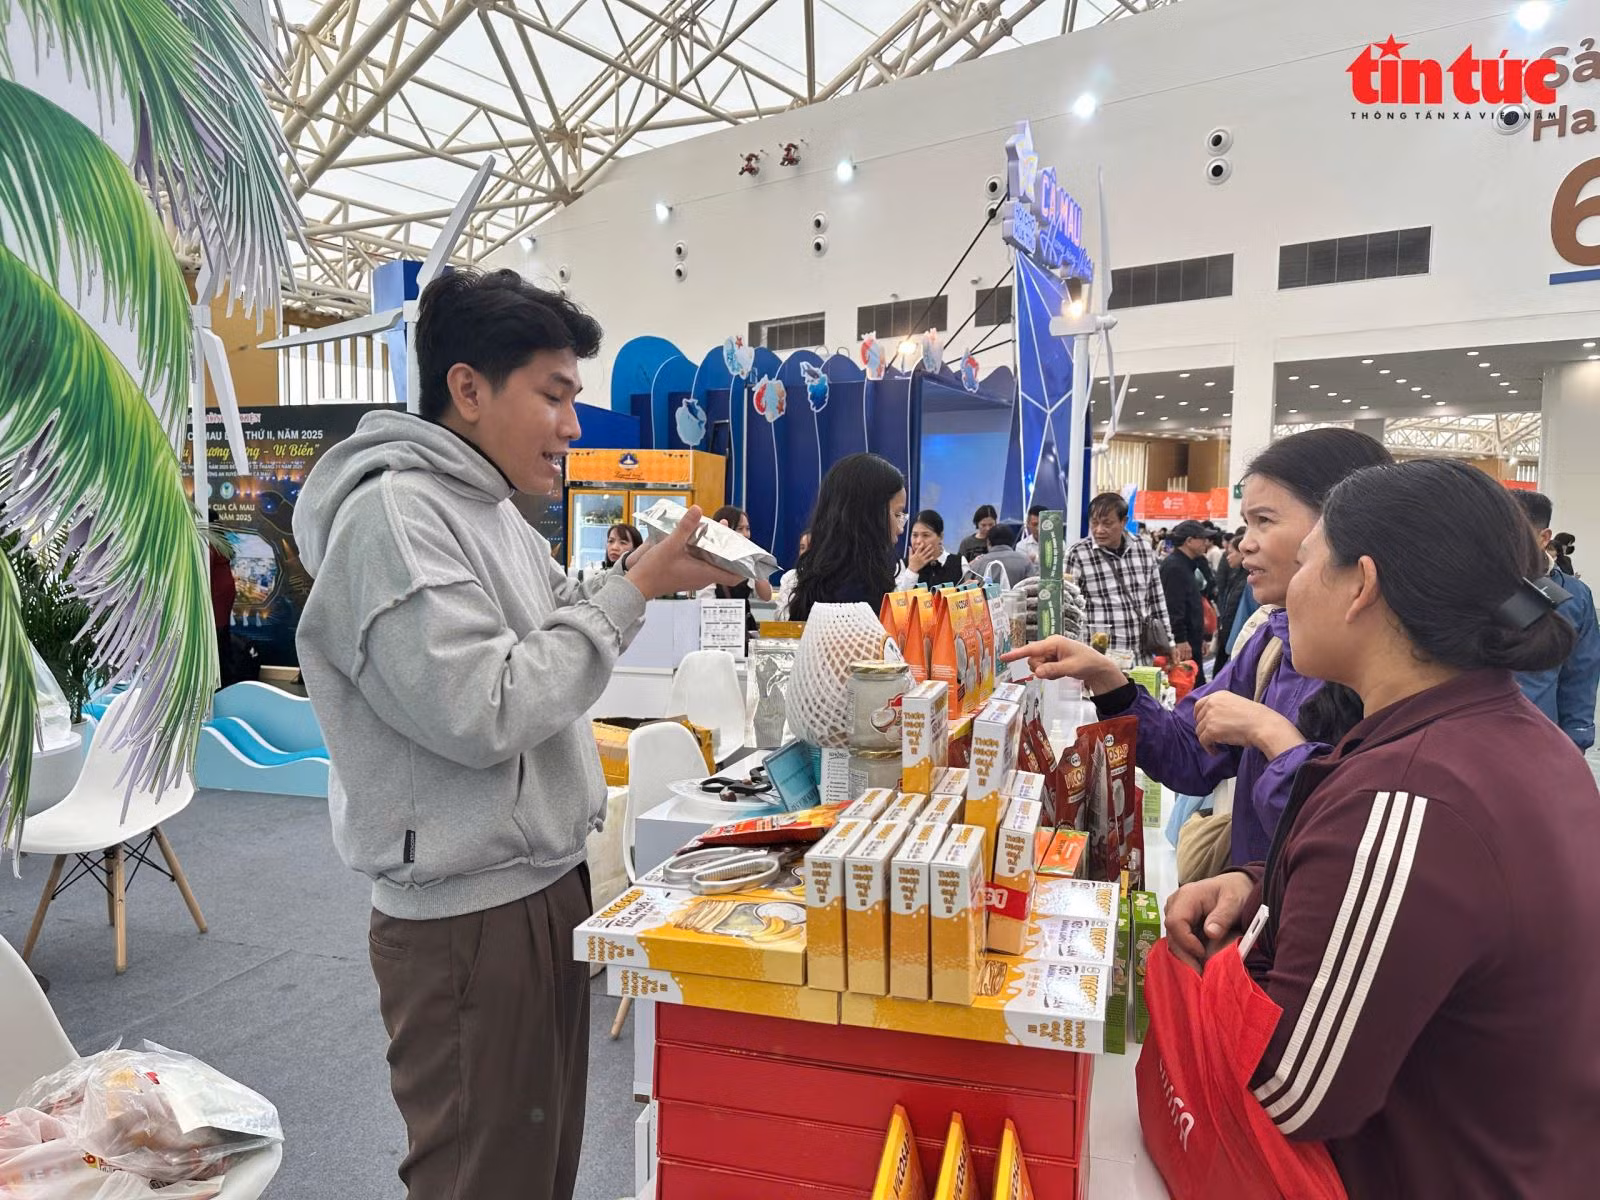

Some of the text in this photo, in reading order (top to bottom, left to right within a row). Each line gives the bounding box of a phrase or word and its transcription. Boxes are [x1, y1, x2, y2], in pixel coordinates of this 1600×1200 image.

[1059, 187, 1081, 248] MAU
[245, 430, 265, 440] THỨ
[277, 428, 299, 440] NĂM
[301, 430, 323, 440] 2025
[227, 502, 238, 511] CÀ
[218, 512, 234, 521] NĂM
